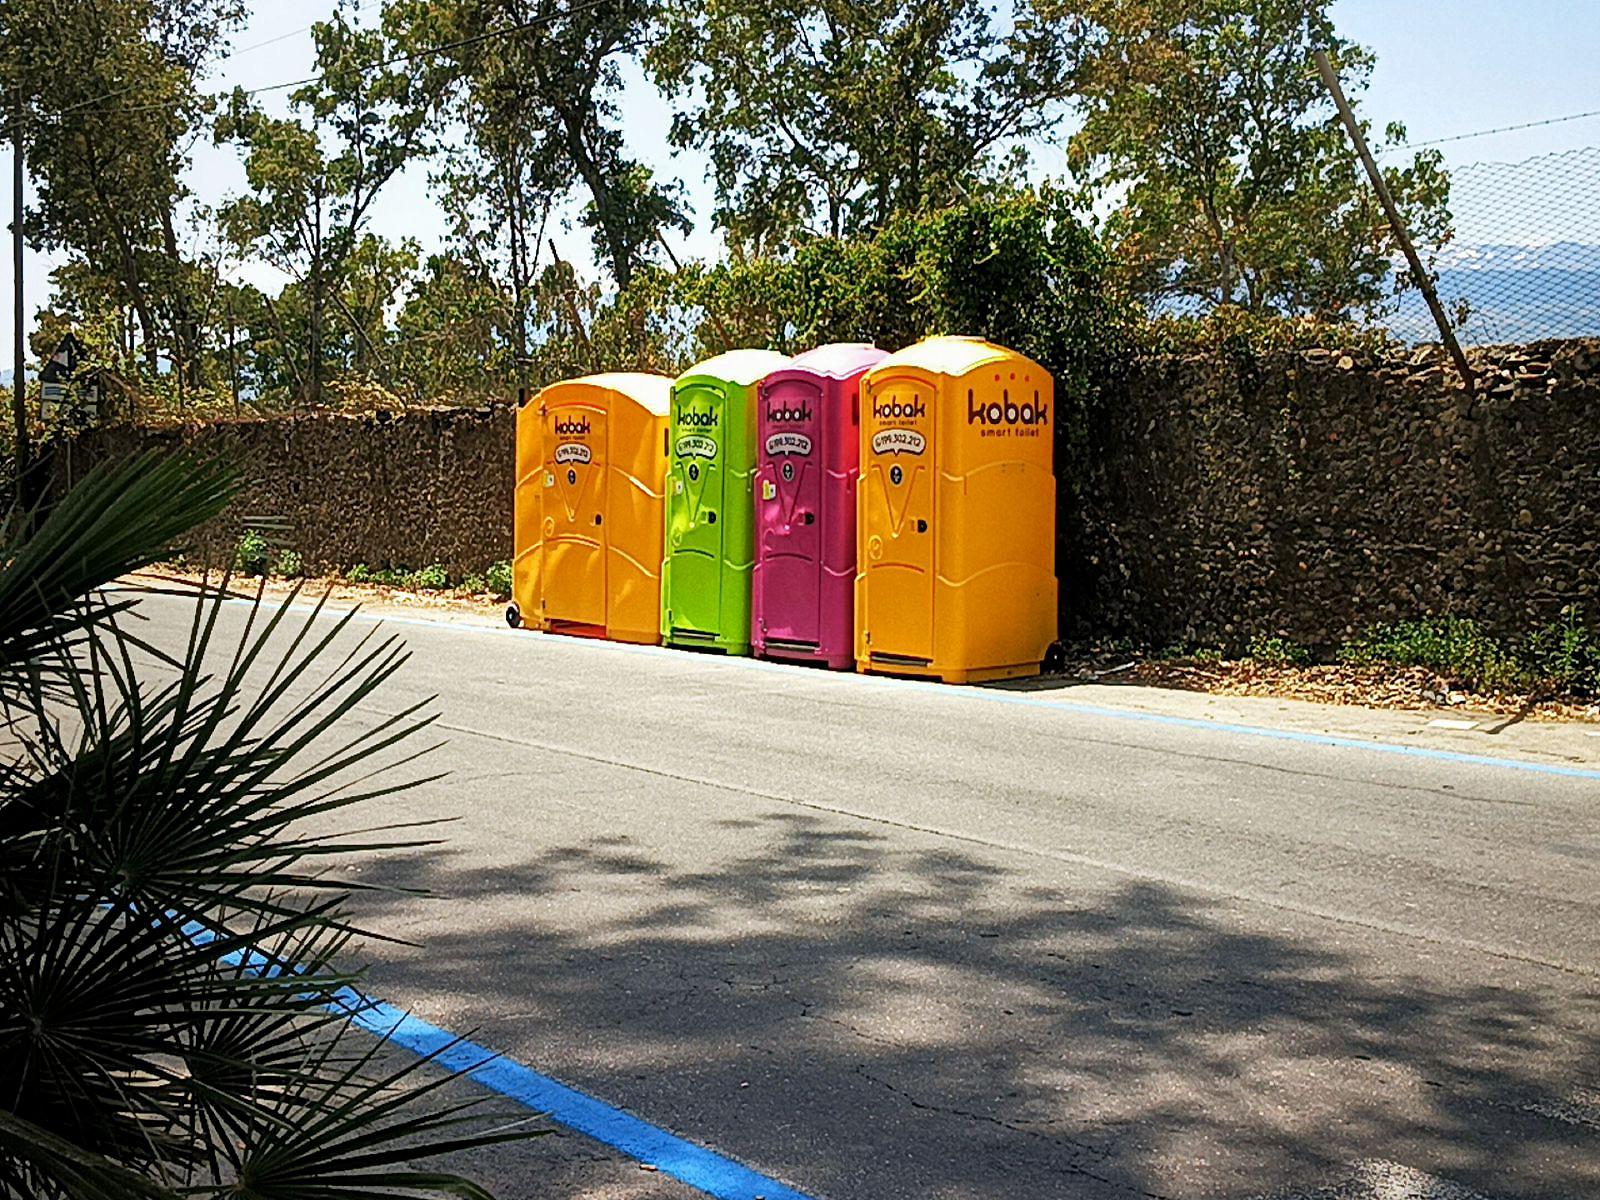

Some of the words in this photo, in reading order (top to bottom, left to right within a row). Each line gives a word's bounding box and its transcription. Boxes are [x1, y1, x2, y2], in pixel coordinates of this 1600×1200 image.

[677, 404, 718, 426] kobak
[767, 400, 812, 422] kobak
[873, 394, 926, 419] kobak
[967, 388, 1048, 425] kobak
[555, 415, 591, 435] kobak
[980, 428, 1011, 437] smart
[1015, 427, 1039, 437] toilet
